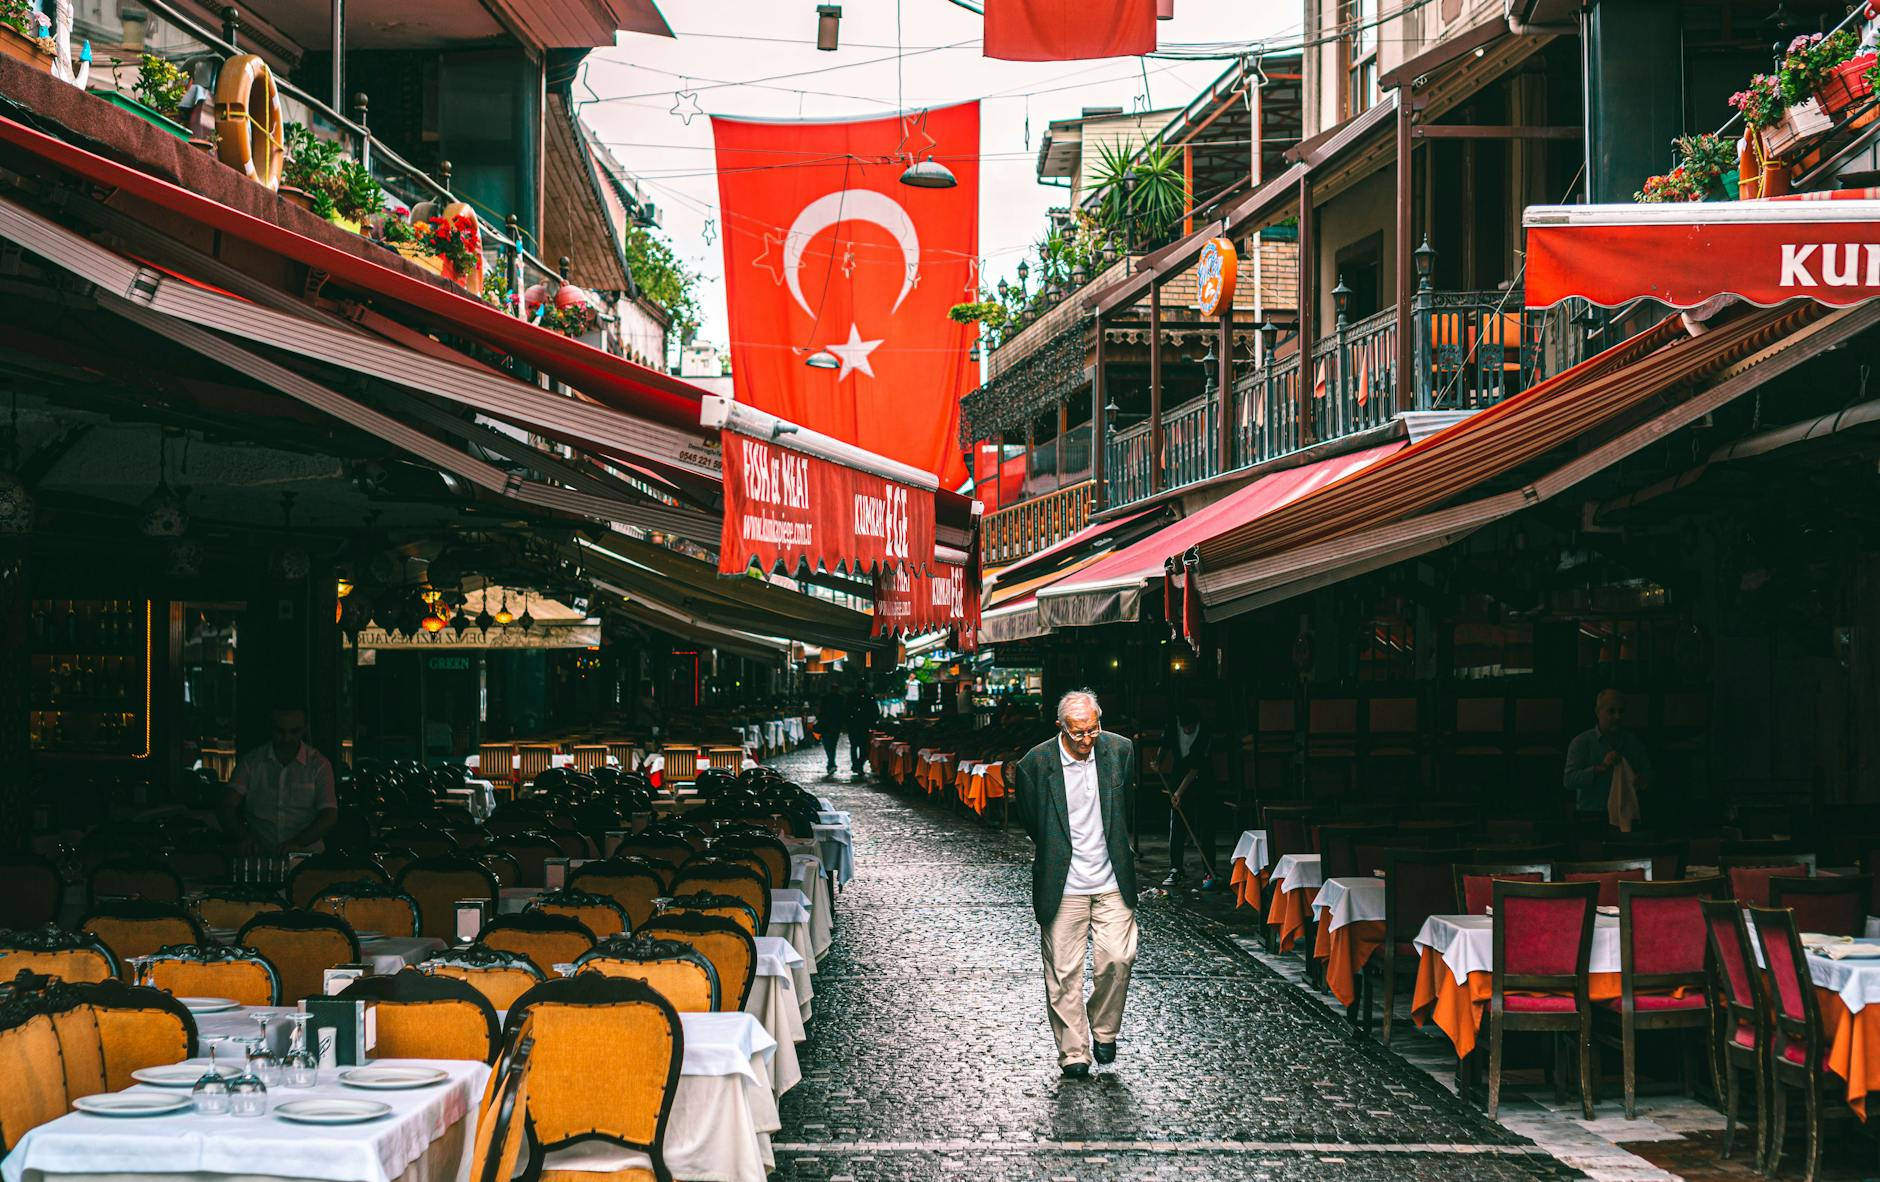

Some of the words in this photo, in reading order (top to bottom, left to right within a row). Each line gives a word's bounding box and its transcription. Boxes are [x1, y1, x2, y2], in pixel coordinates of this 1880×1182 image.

[680, 451, 697, 462] 0545
[698, 456, 711, 466] 221
[743, 440, 770, 502] FISH
[771, 457, 781, 504] &
[782, 452, 809, 509] MEAT
[886, 484, 909, 558] EGE
